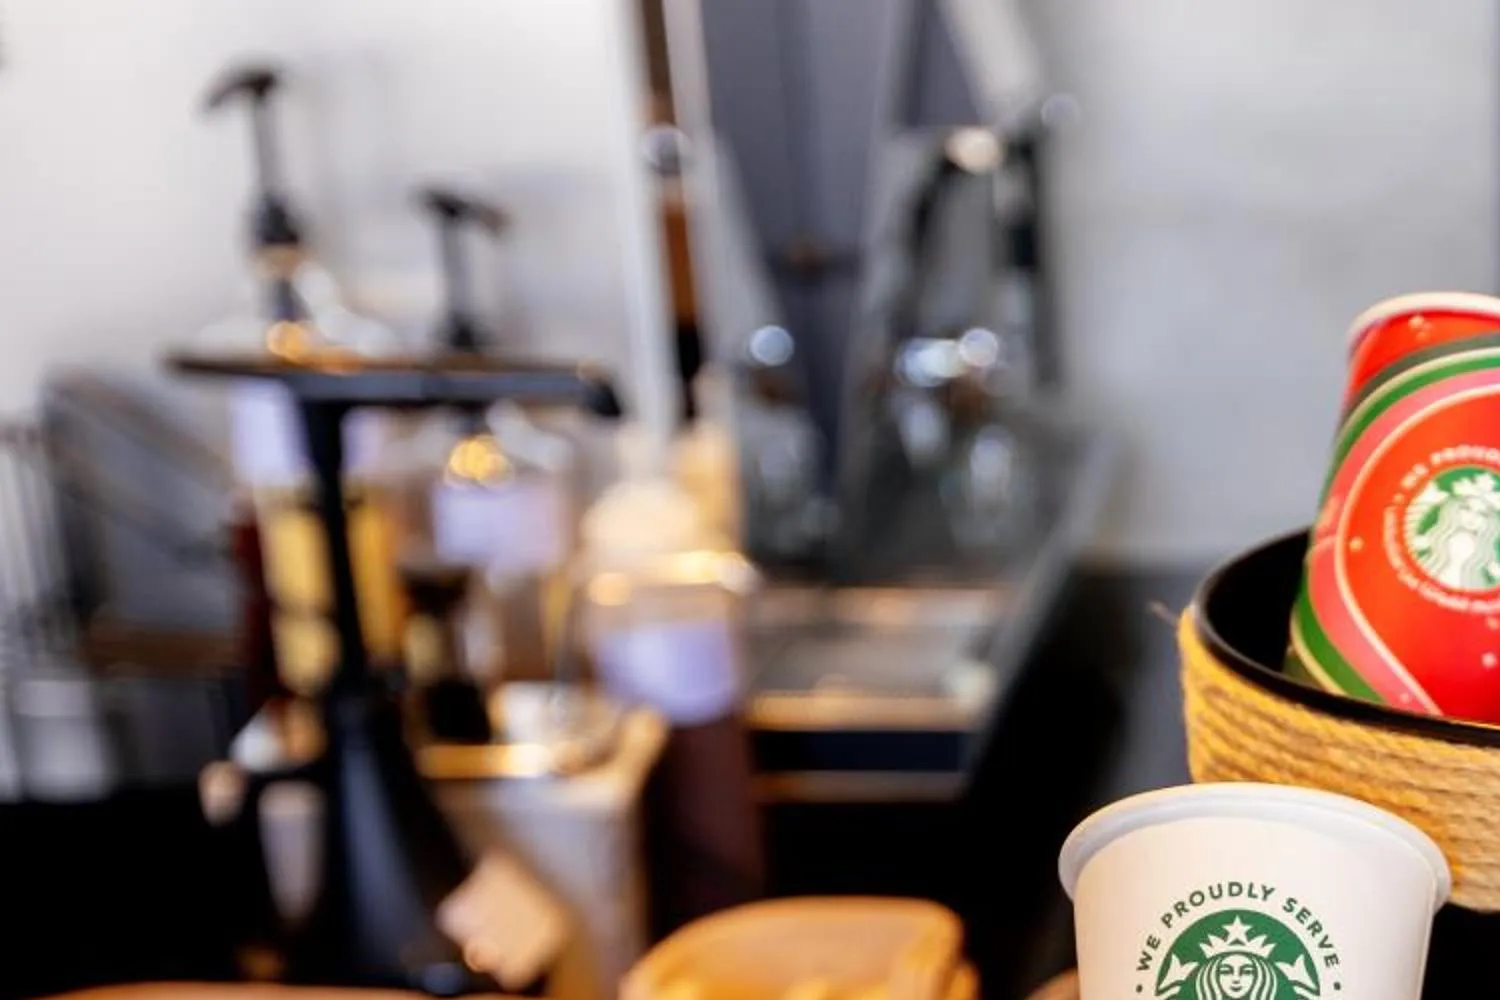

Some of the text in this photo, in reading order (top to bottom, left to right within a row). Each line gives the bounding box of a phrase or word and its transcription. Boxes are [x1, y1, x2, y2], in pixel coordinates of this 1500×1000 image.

[1136, 881, 1340, 972] WE PROUDLY SERVE
